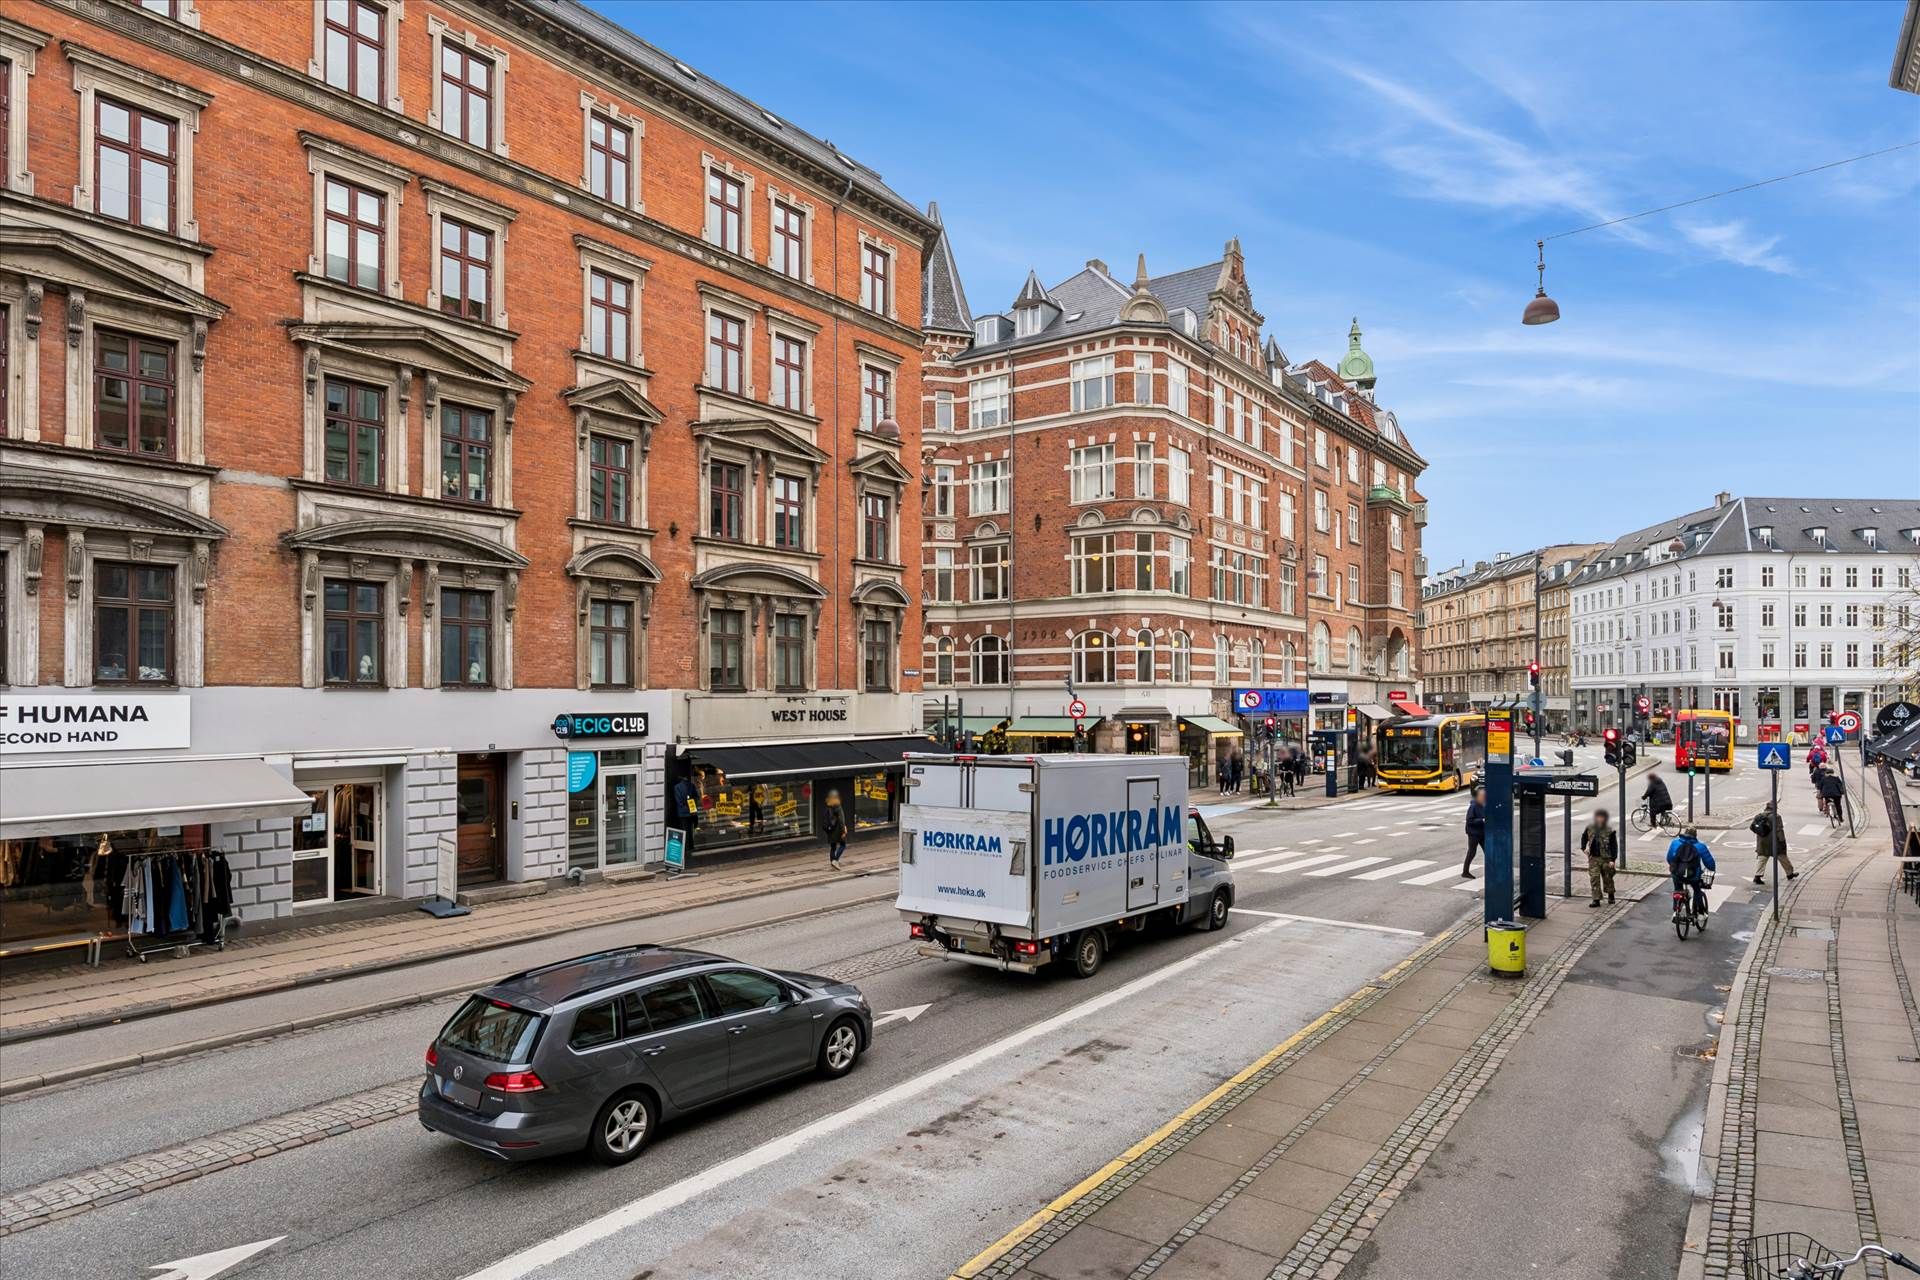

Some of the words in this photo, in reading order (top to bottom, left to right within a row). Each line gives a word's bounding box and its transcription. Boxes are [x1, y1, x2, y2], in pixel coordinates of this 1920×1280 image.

[18, 705, 149, 724] HUMANA
[771, 710, 806, 722] WEST
[809, 710, 847, 721] HOUSE
[1839, 718, 1856, 727] 40
[1881, 719, 1902, 727] WOK
[67, 731, 118, 743] HAND
[923, 830, 1002, 853] HØRKRAM
[1044, 805, 1182, 866] HØRKRAM
[1044, 860, 1113, 880] FOODSERVICE
[1149, 848, 1183, 861] CLINAR
[937, 885, 986, 898] www.hoka.dk
